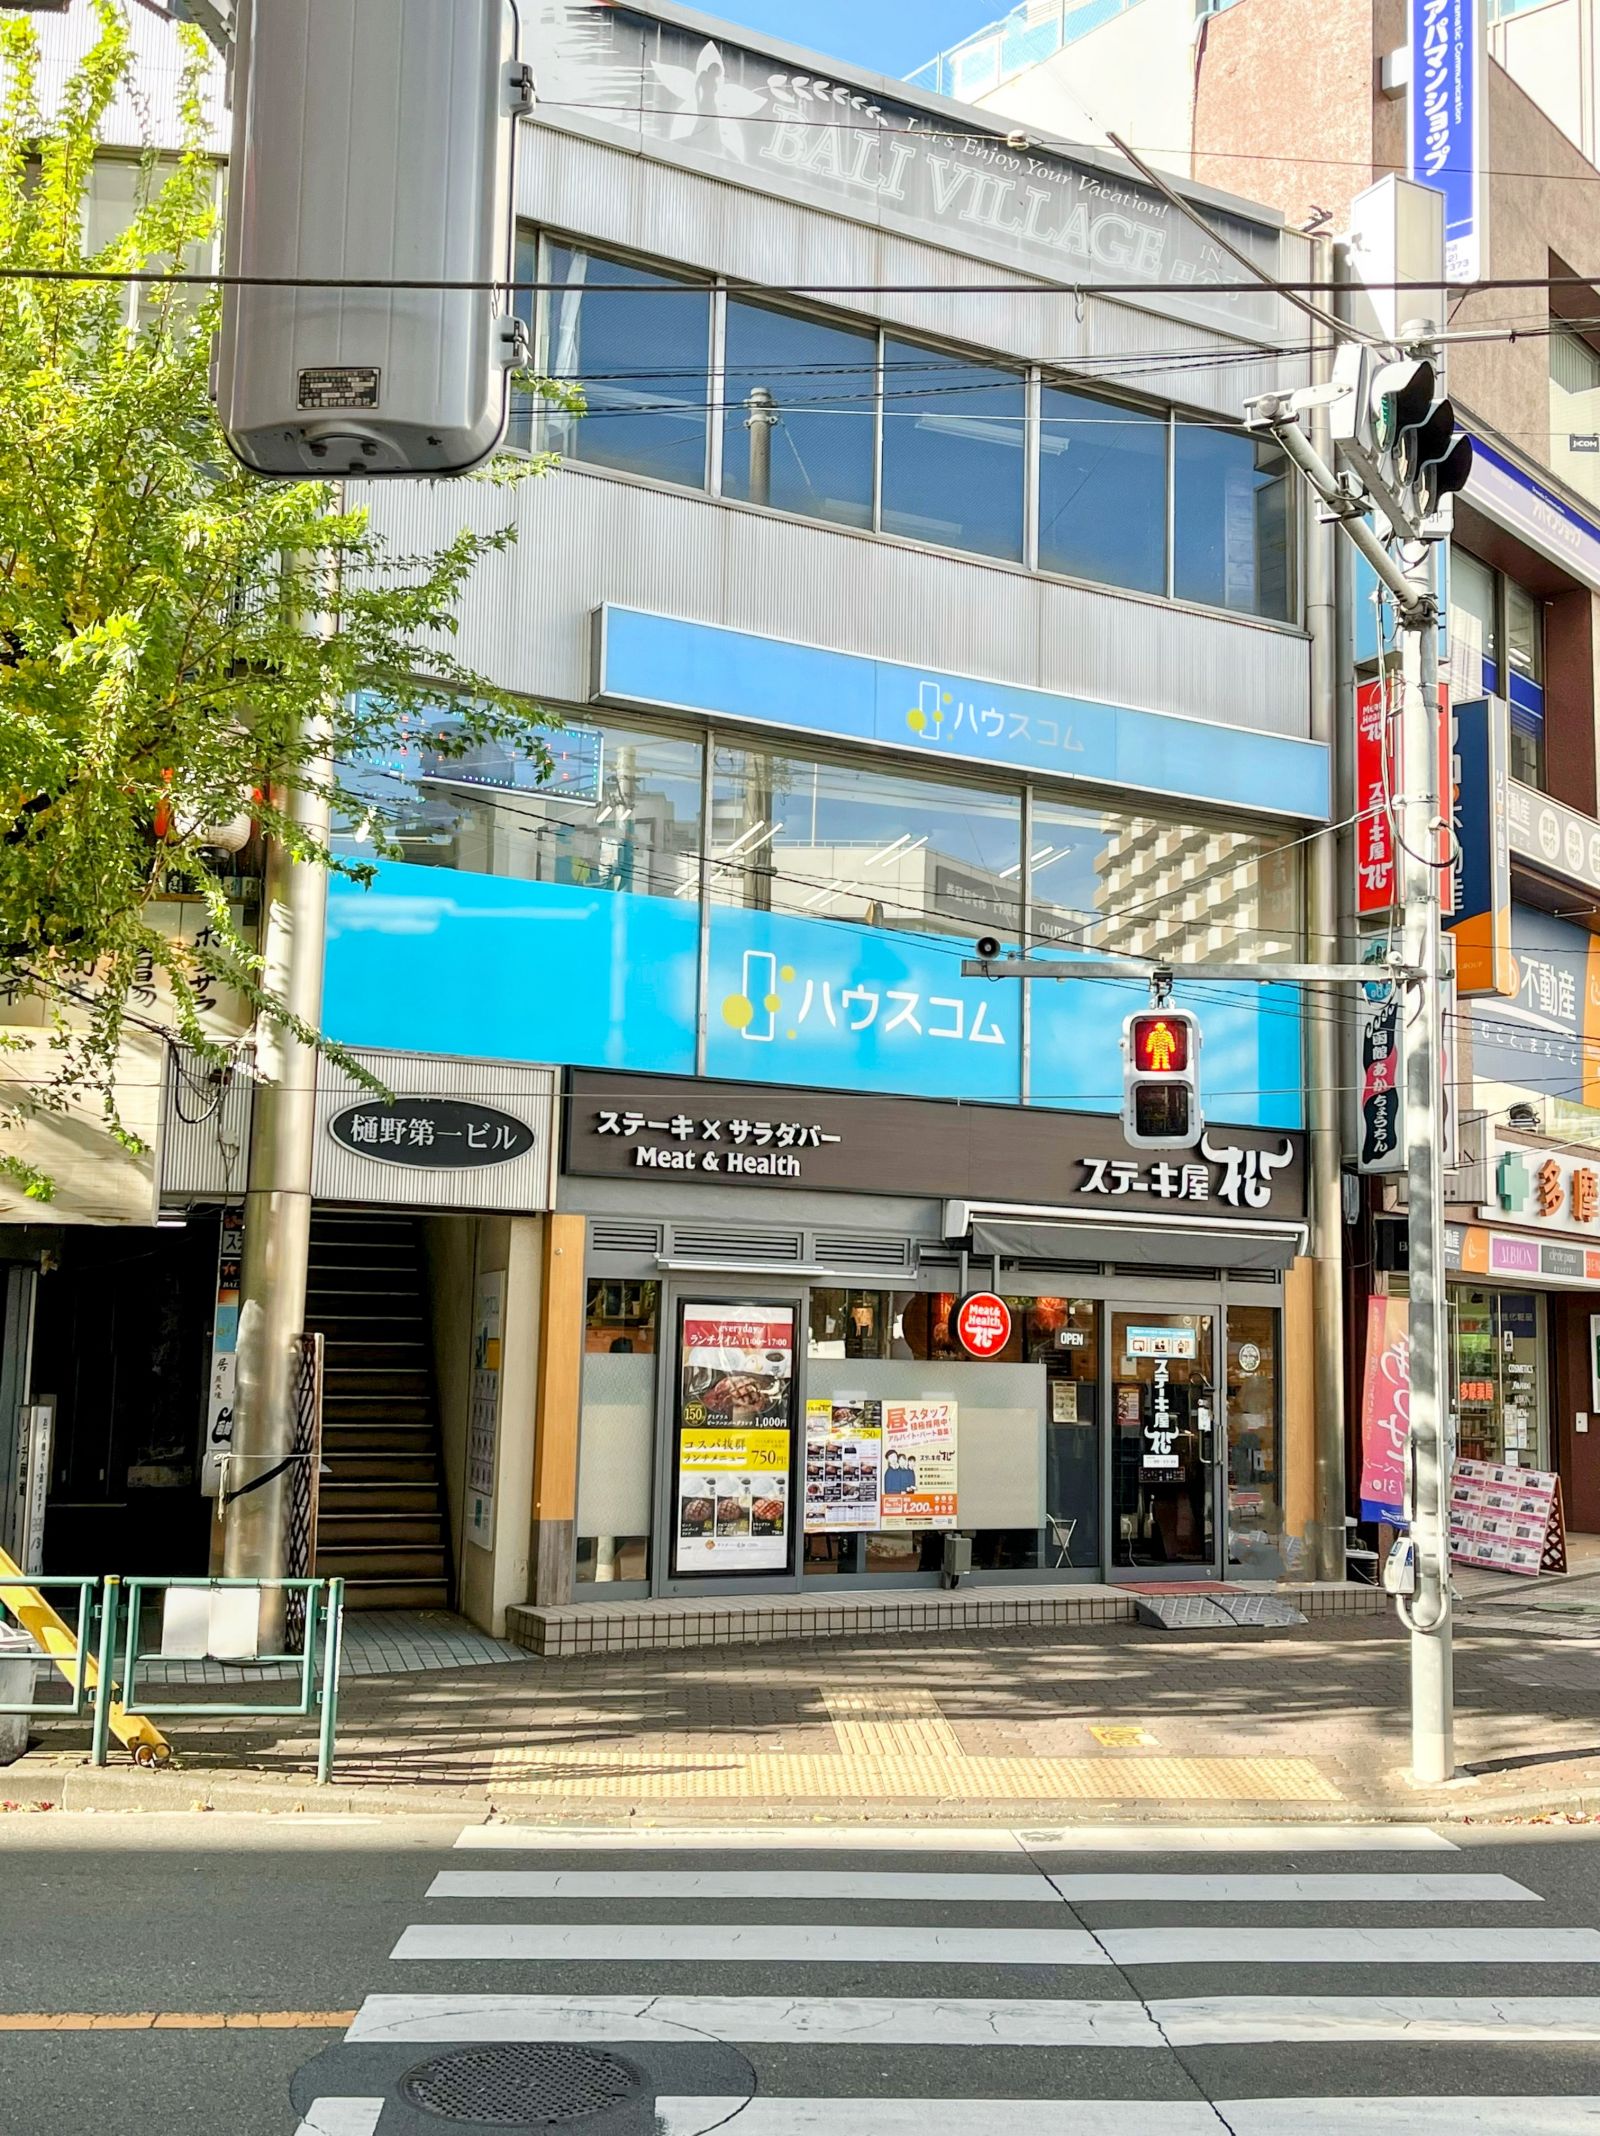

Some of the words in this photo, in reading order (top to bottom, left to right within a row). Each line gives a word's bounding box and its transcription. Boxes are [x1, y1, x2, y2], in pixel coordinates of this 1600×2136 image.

[1454, 42, 1464, 125] Communication
[759, 103, 905, 200] BALI
[926, 152, 1167, 279] VILLAGE
[902, 116, 954, 148] Let's
[962, 137, 1021, 171] Enjoy
[1026, 156, 1073, 186] Your
[1077, 175, 1169, 219] Vacation!
[953, 701, 1084, 752] ハウスコム
[797, 979, 1006, 1045] ハウスコム
[1520, 955, 1577, 1021] 不動産
[1372, 1030, 1389, 1153] 函館あかちょうちん
[350, 1114, 518, 1150] 樋野第一ビル
[597, 1110, 695, 1141] ステーキ
[728, 1118, 842, 1148] サラダバー
[635, 1146, 697, 1170] Meat
[701, 1151, 721, 1172] &
[726, 1152, 802, 1177] Health
[968, 1315, 1001, 1327] Health
[1060, 1331, 1084, 1346] OPEN
